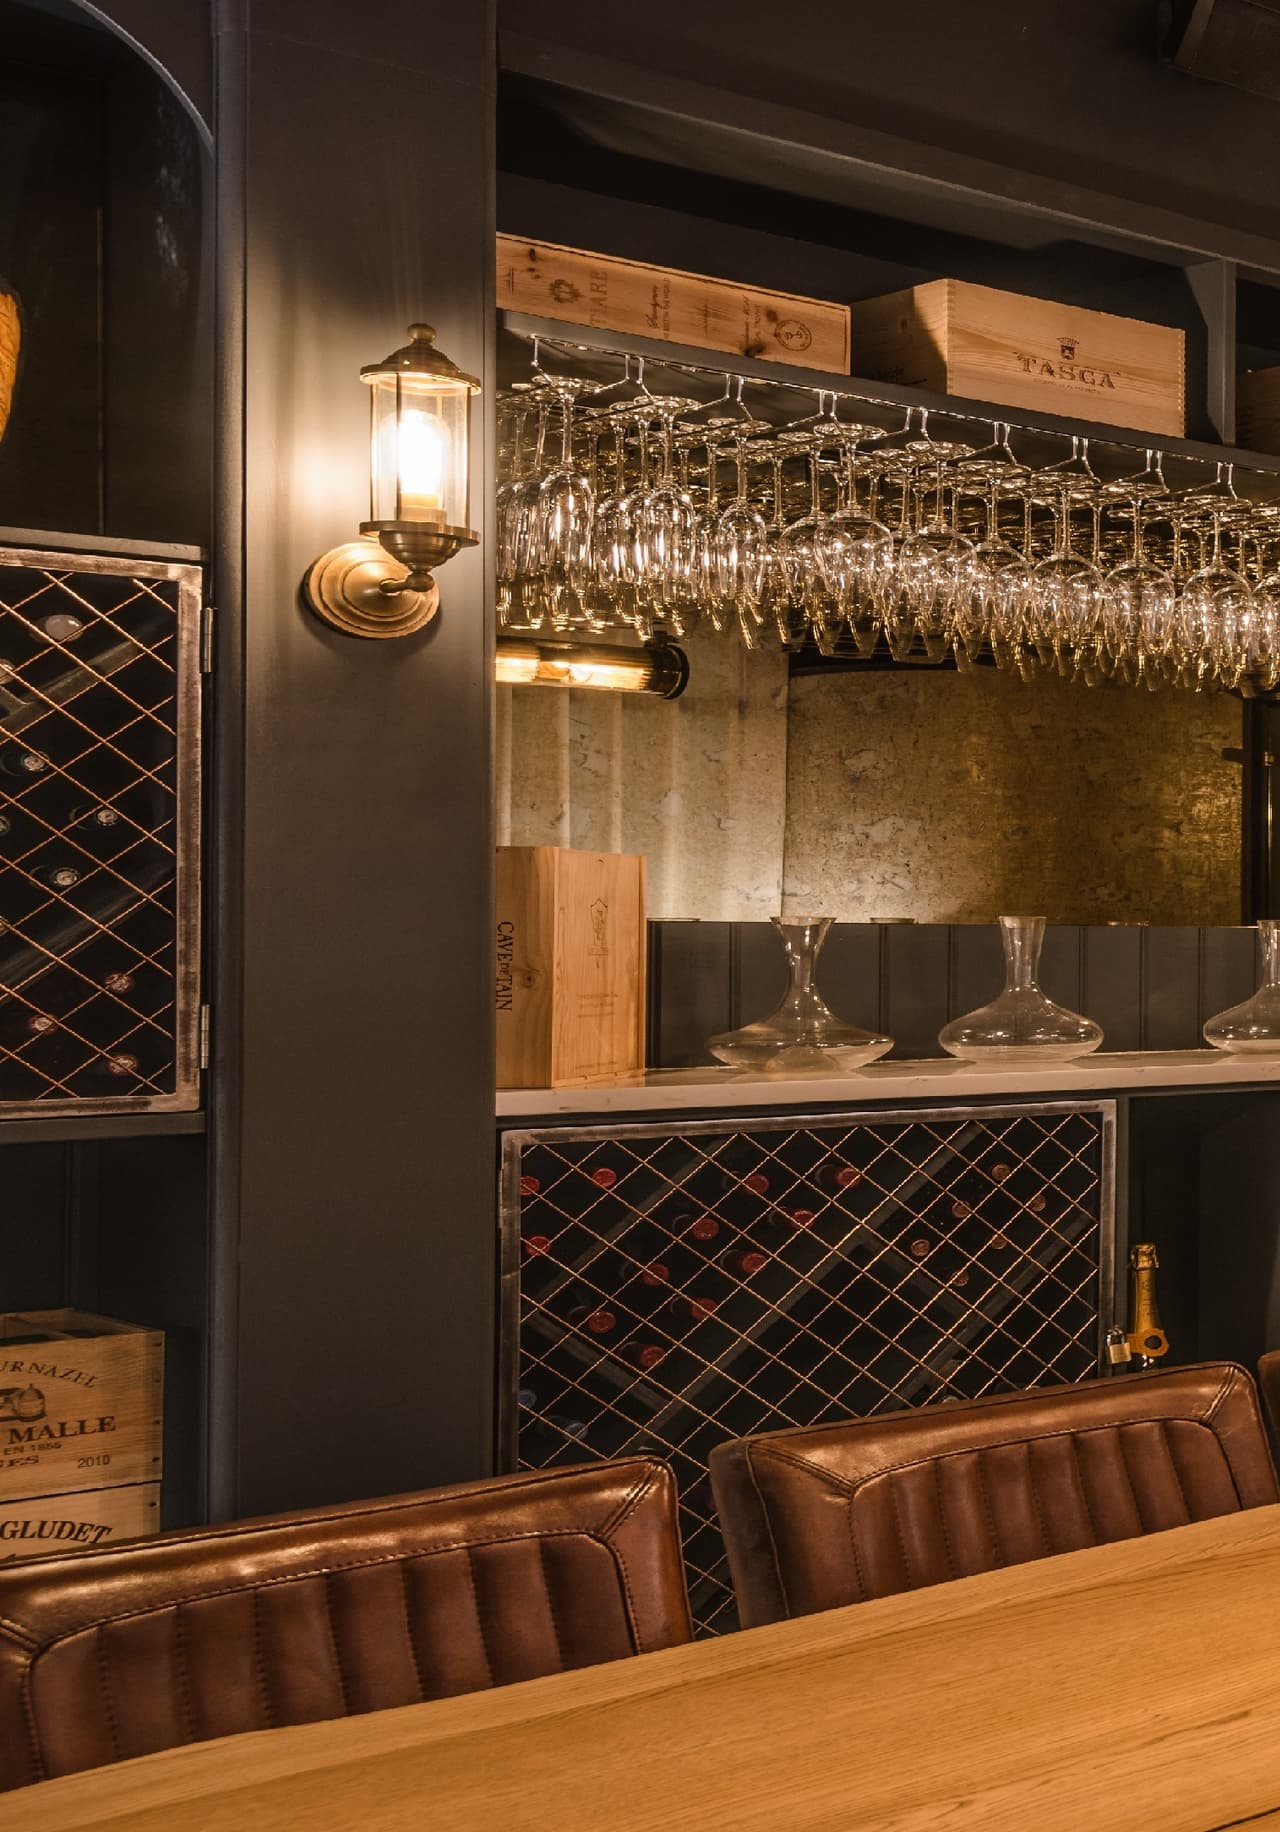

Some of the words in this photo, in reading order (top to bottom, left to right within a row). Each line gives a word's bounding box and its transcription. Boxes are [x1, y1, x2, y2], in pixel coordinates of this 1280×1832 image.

[1012, 351, 1121, 390] TASCA
[497, 922, 514, 961] CAVE
[500, 963, 509, 975] DE
[496, 975, 512, 1011] TAIN
[8, 1416, 116, 1445] MALLE
[4, 1446, 24, 1455] EN
[78, 1454, 111, 1469] 2010
[1, 1520, 113, 1544] GLUDET
